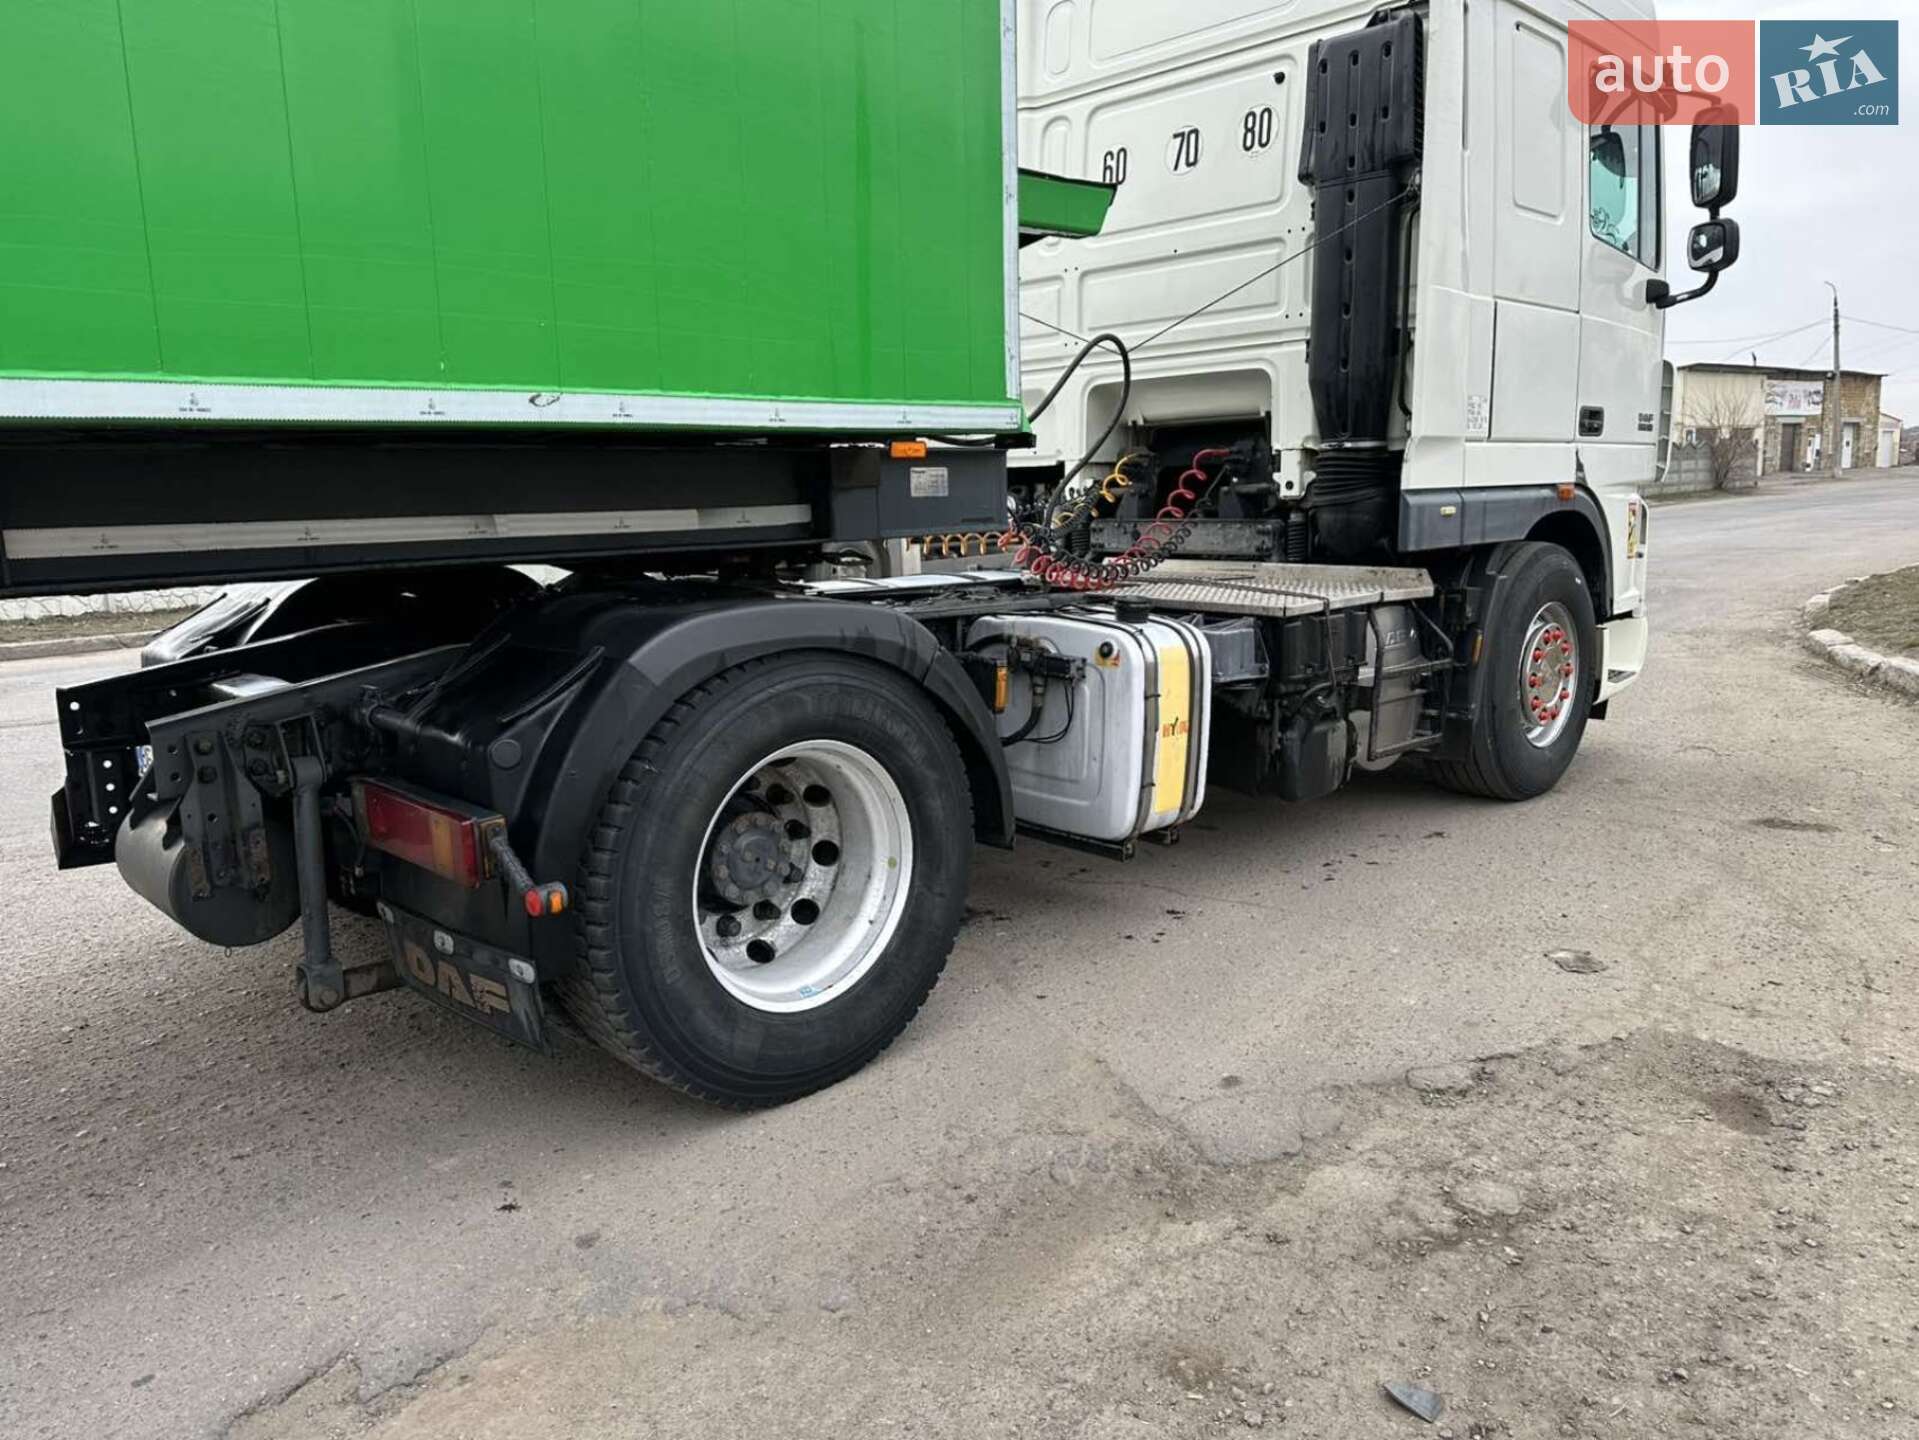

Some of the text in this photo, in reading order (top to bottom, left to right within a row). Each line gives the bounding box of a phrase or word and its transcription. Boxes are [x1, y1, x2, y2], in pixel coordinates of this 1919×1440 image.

[1102, 107, 1272, 185] 60 70 80
[403, 941, 511, 1014] DAF
